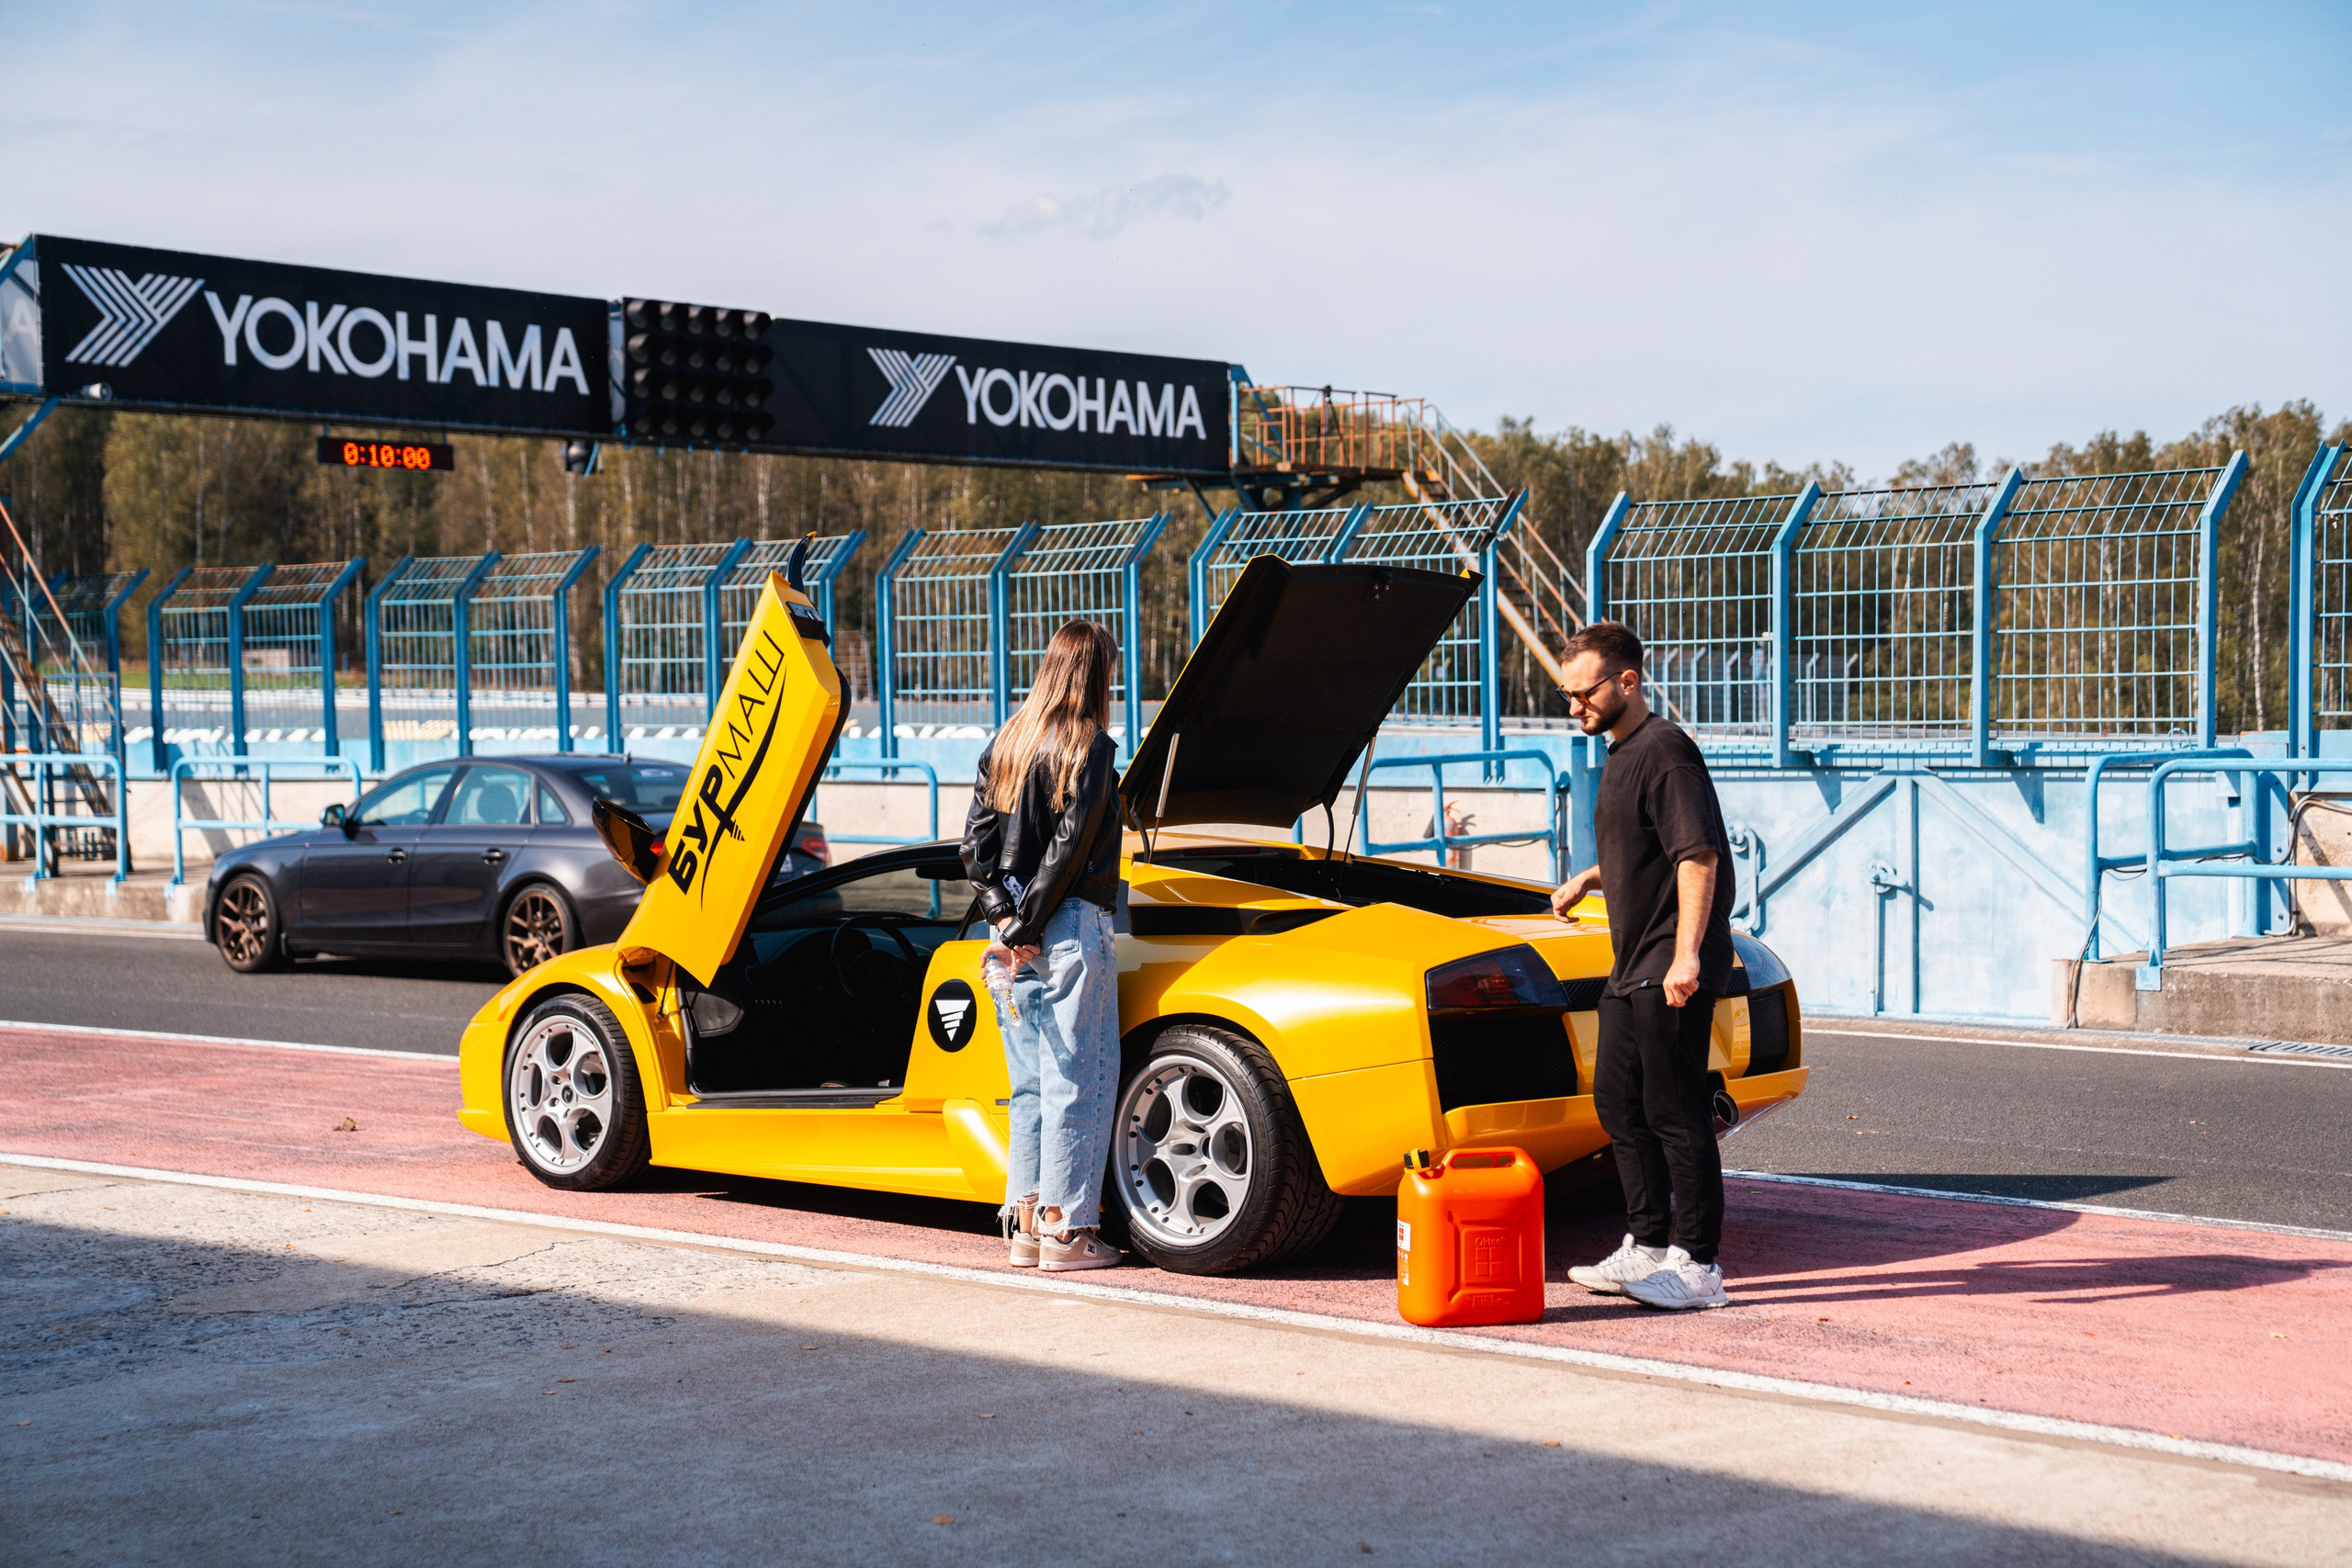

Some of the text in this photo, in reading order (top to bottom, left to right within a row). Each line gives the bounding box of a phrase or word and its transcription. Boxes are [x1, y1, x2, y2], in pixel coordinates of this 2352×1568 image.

[203, 290, 591, 396] YOKOHAMA
[955, 364, 1207, 440] YOKOHAMA
[343, 442, 431, 470] 0:10:00
[667, 629, 785, 896] БУРМАШ
